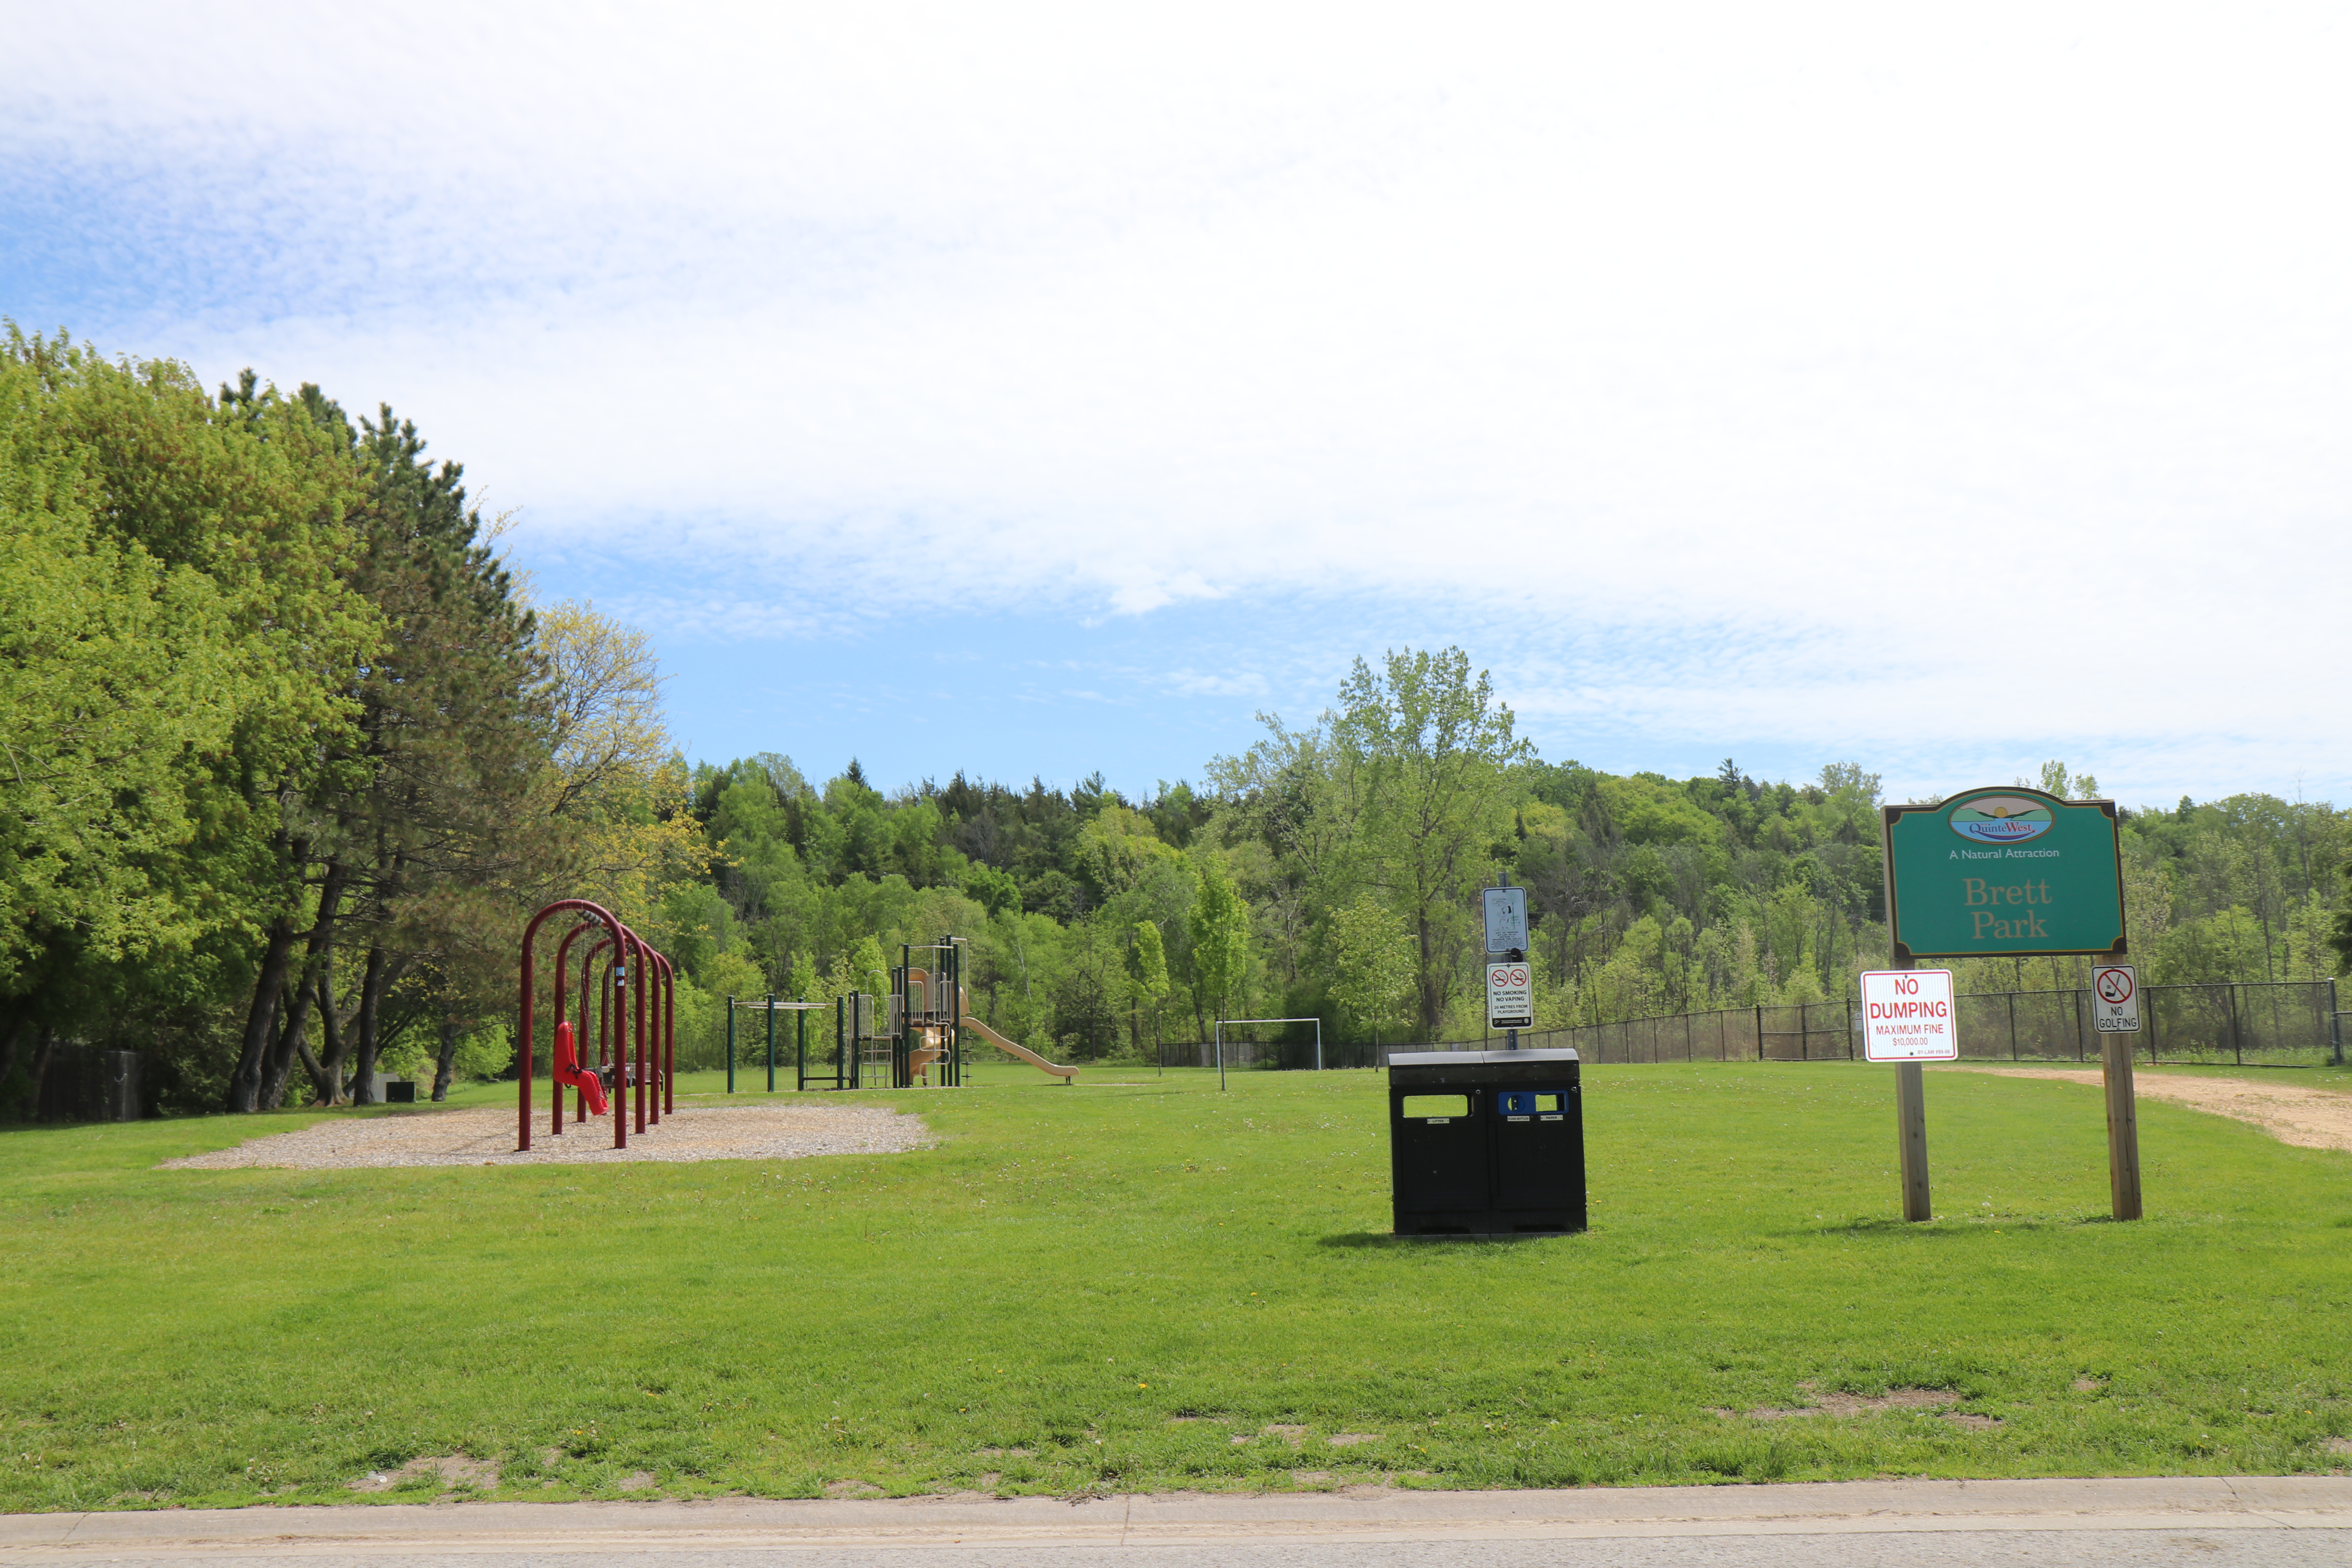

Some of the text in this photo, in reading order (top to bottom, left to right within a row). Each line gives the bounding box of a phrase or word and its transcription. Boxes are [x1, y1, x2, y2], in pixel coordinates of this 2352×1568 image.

[1949, 848, 2060, 859] A Natural Attraction
[1962, 878, 2052, 906] Brett
[1971, 910, 2049, 939] Park
[1895, 978, 1918, 995] NO
[1870, 1001, 1947, 1019] DUMPING
[2111, 1007, 2123, 1016] NO
[2100, 1018, 2136, 1028] GOLFING
[1876, 1024, 1944, 1035] MAXIMUM FINE
[1893, 1037, 1928, 1047] $10,000.00
